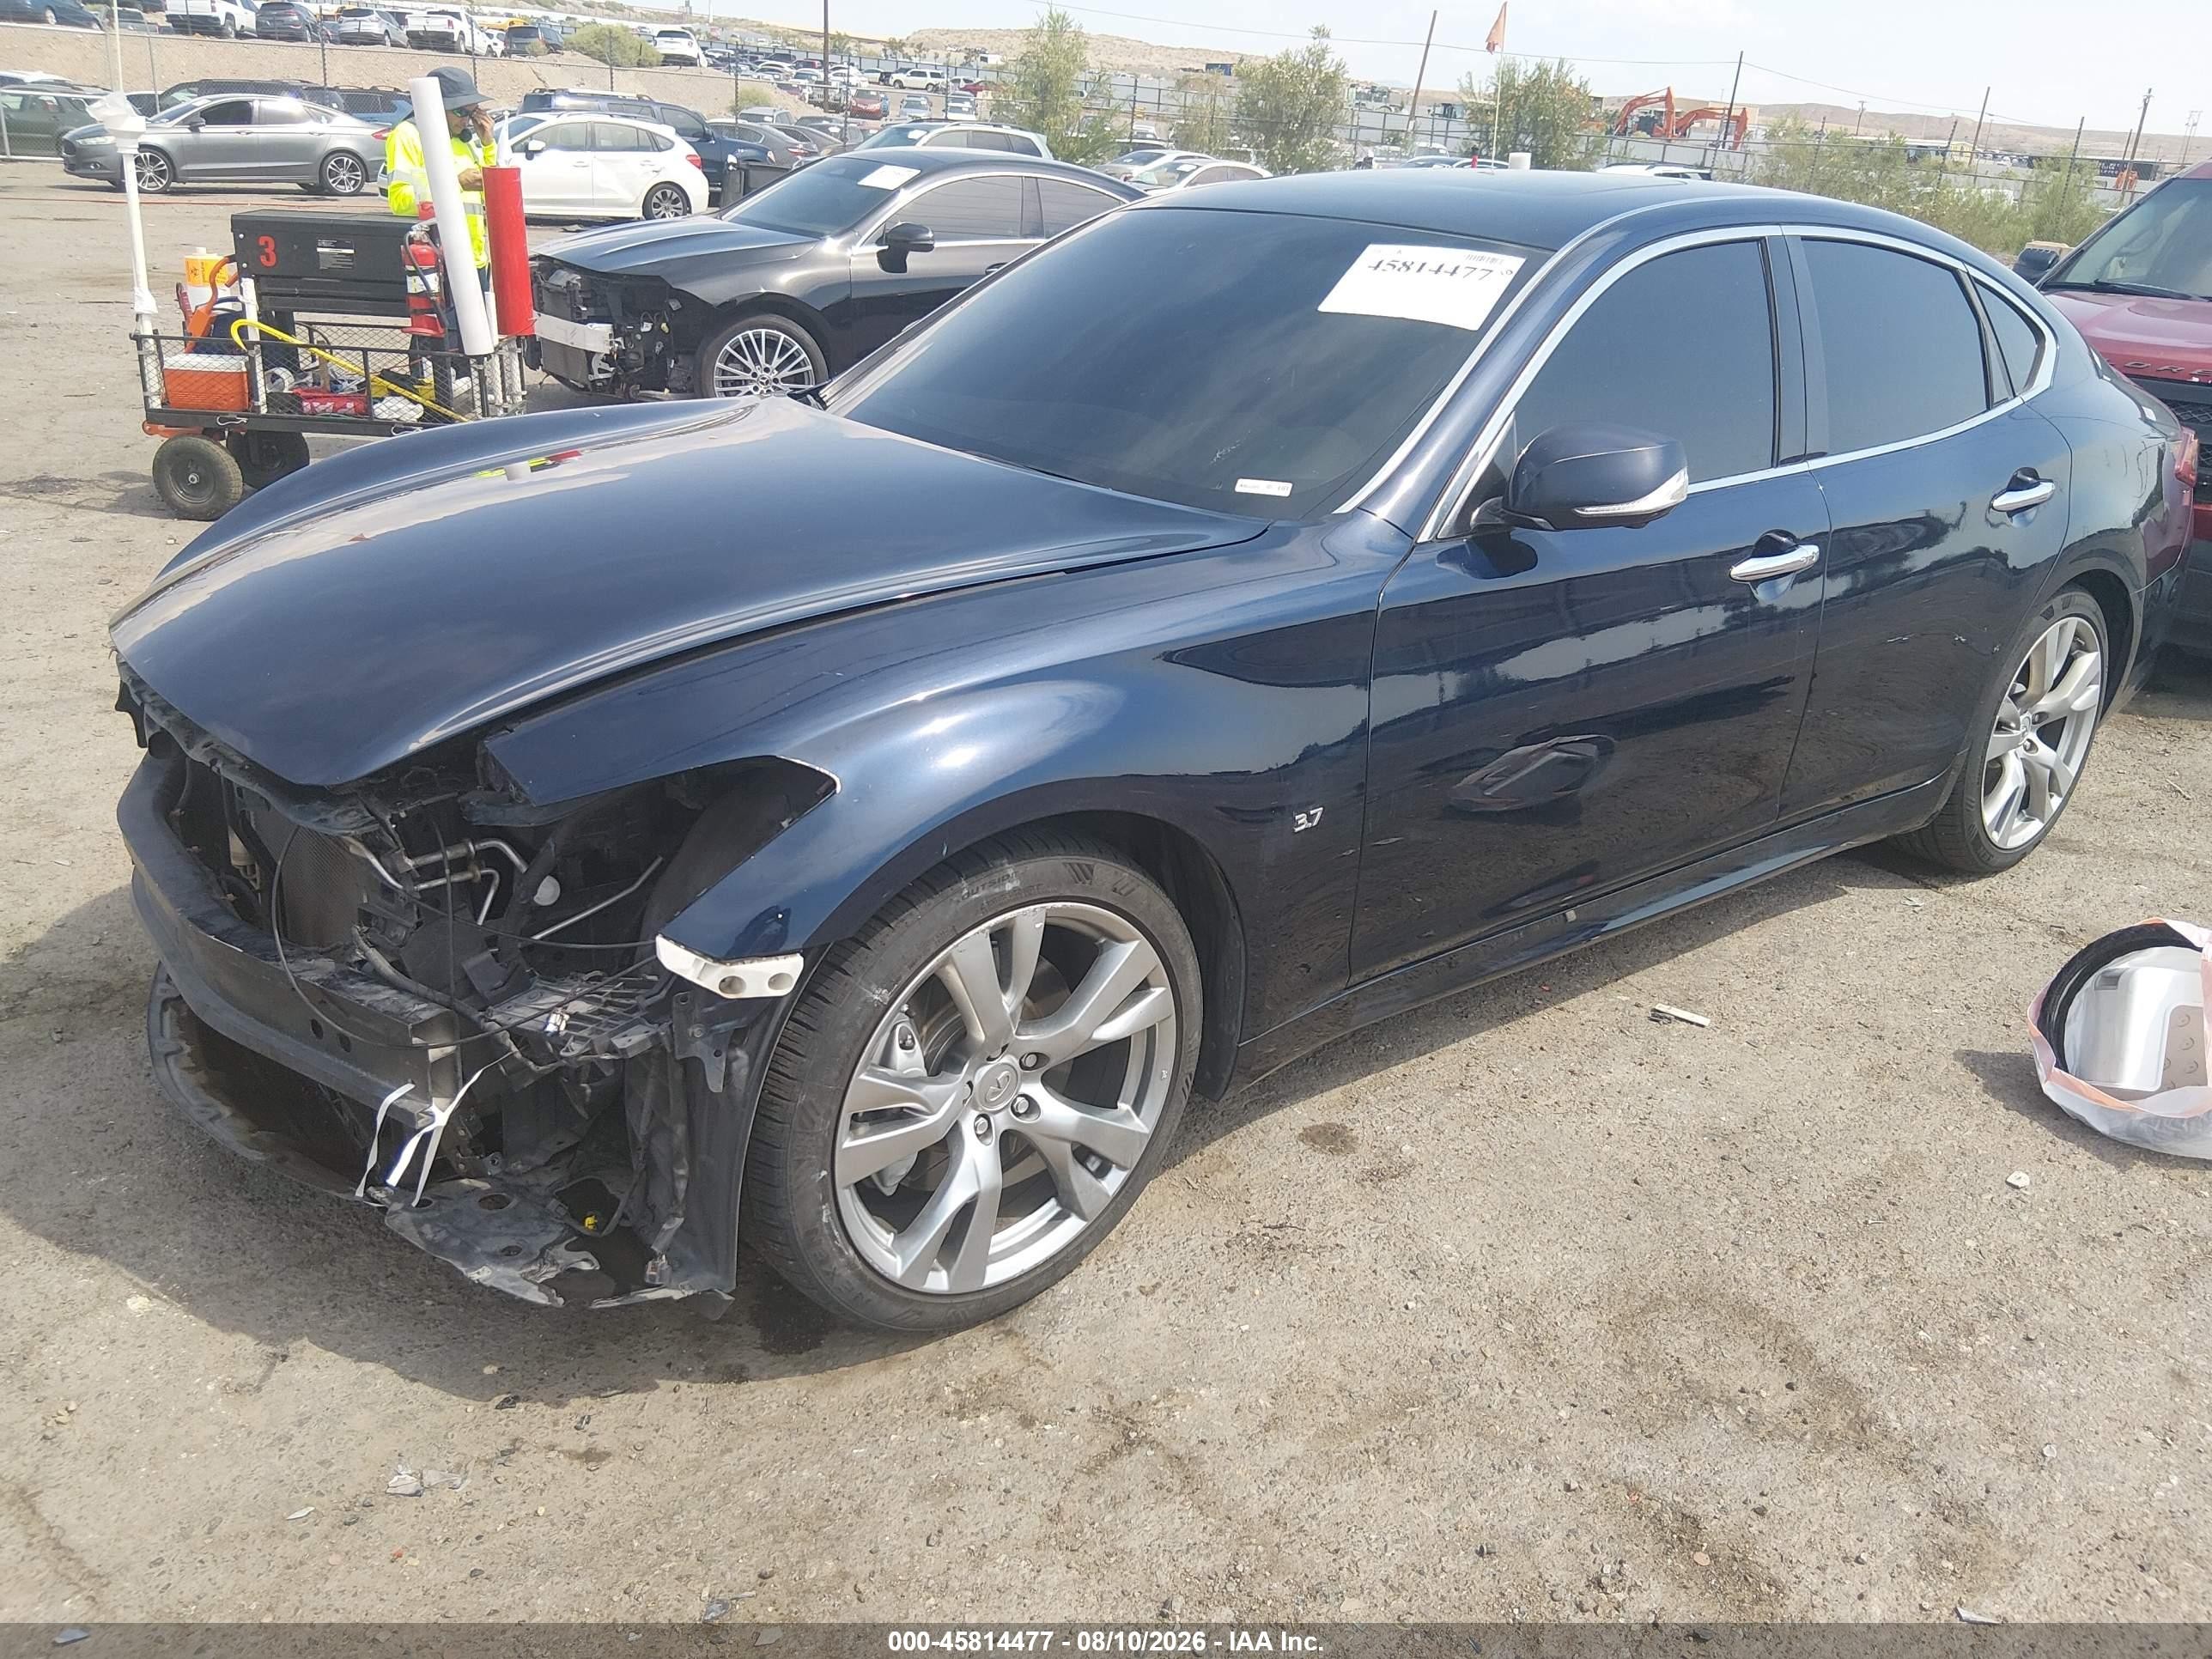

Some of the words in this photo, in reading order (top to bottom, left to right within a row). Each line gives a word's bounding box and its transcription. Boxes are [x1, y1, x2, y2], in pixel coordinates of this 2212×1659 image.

[258, 234, 276, 267] 3
[1368, 259, 1493, 281] 45814477
[1292, 806, 1324, 834] 3.7
